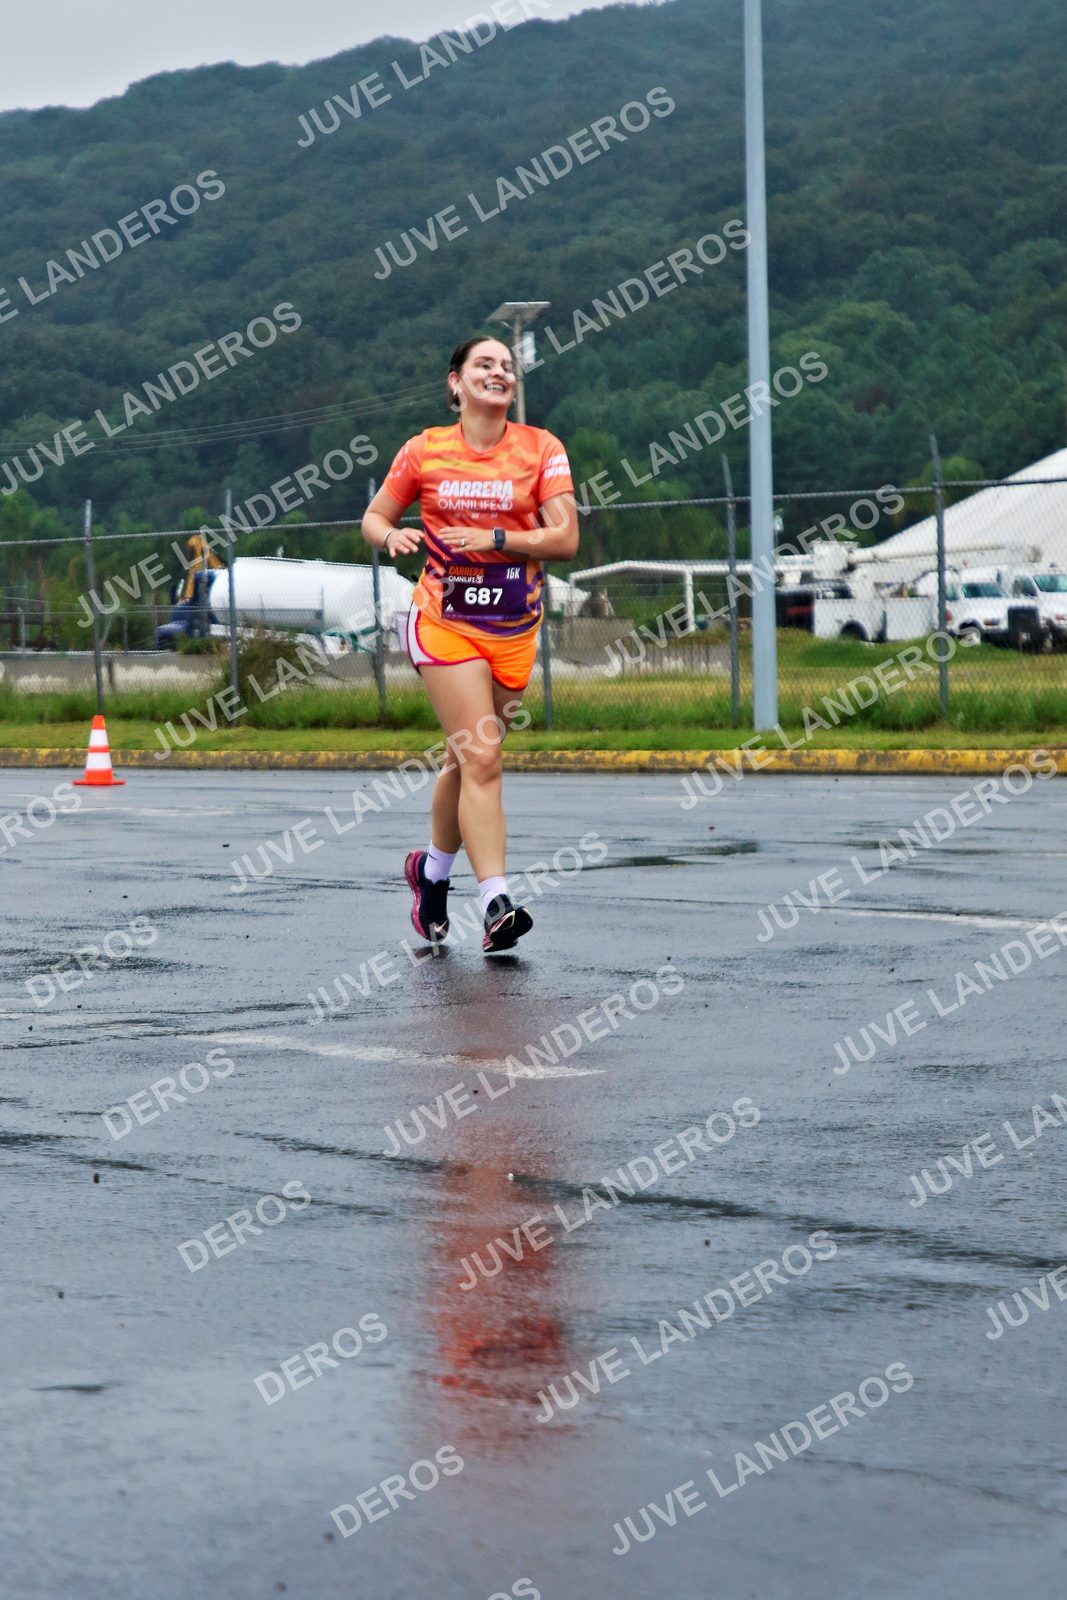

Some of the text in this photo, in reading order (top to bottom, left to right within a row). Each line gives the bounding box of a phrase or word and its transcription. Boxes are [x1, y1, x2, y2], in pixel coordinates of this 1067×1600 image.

[439, 480, 513, 497] CARRERA
[438, 498, 497, 510] OMNILIFE
[449, 565, 485, 577] CARRERA
[448, 575, 476, 584] OMNILIFE
[464, 587, 503, 605] 687
